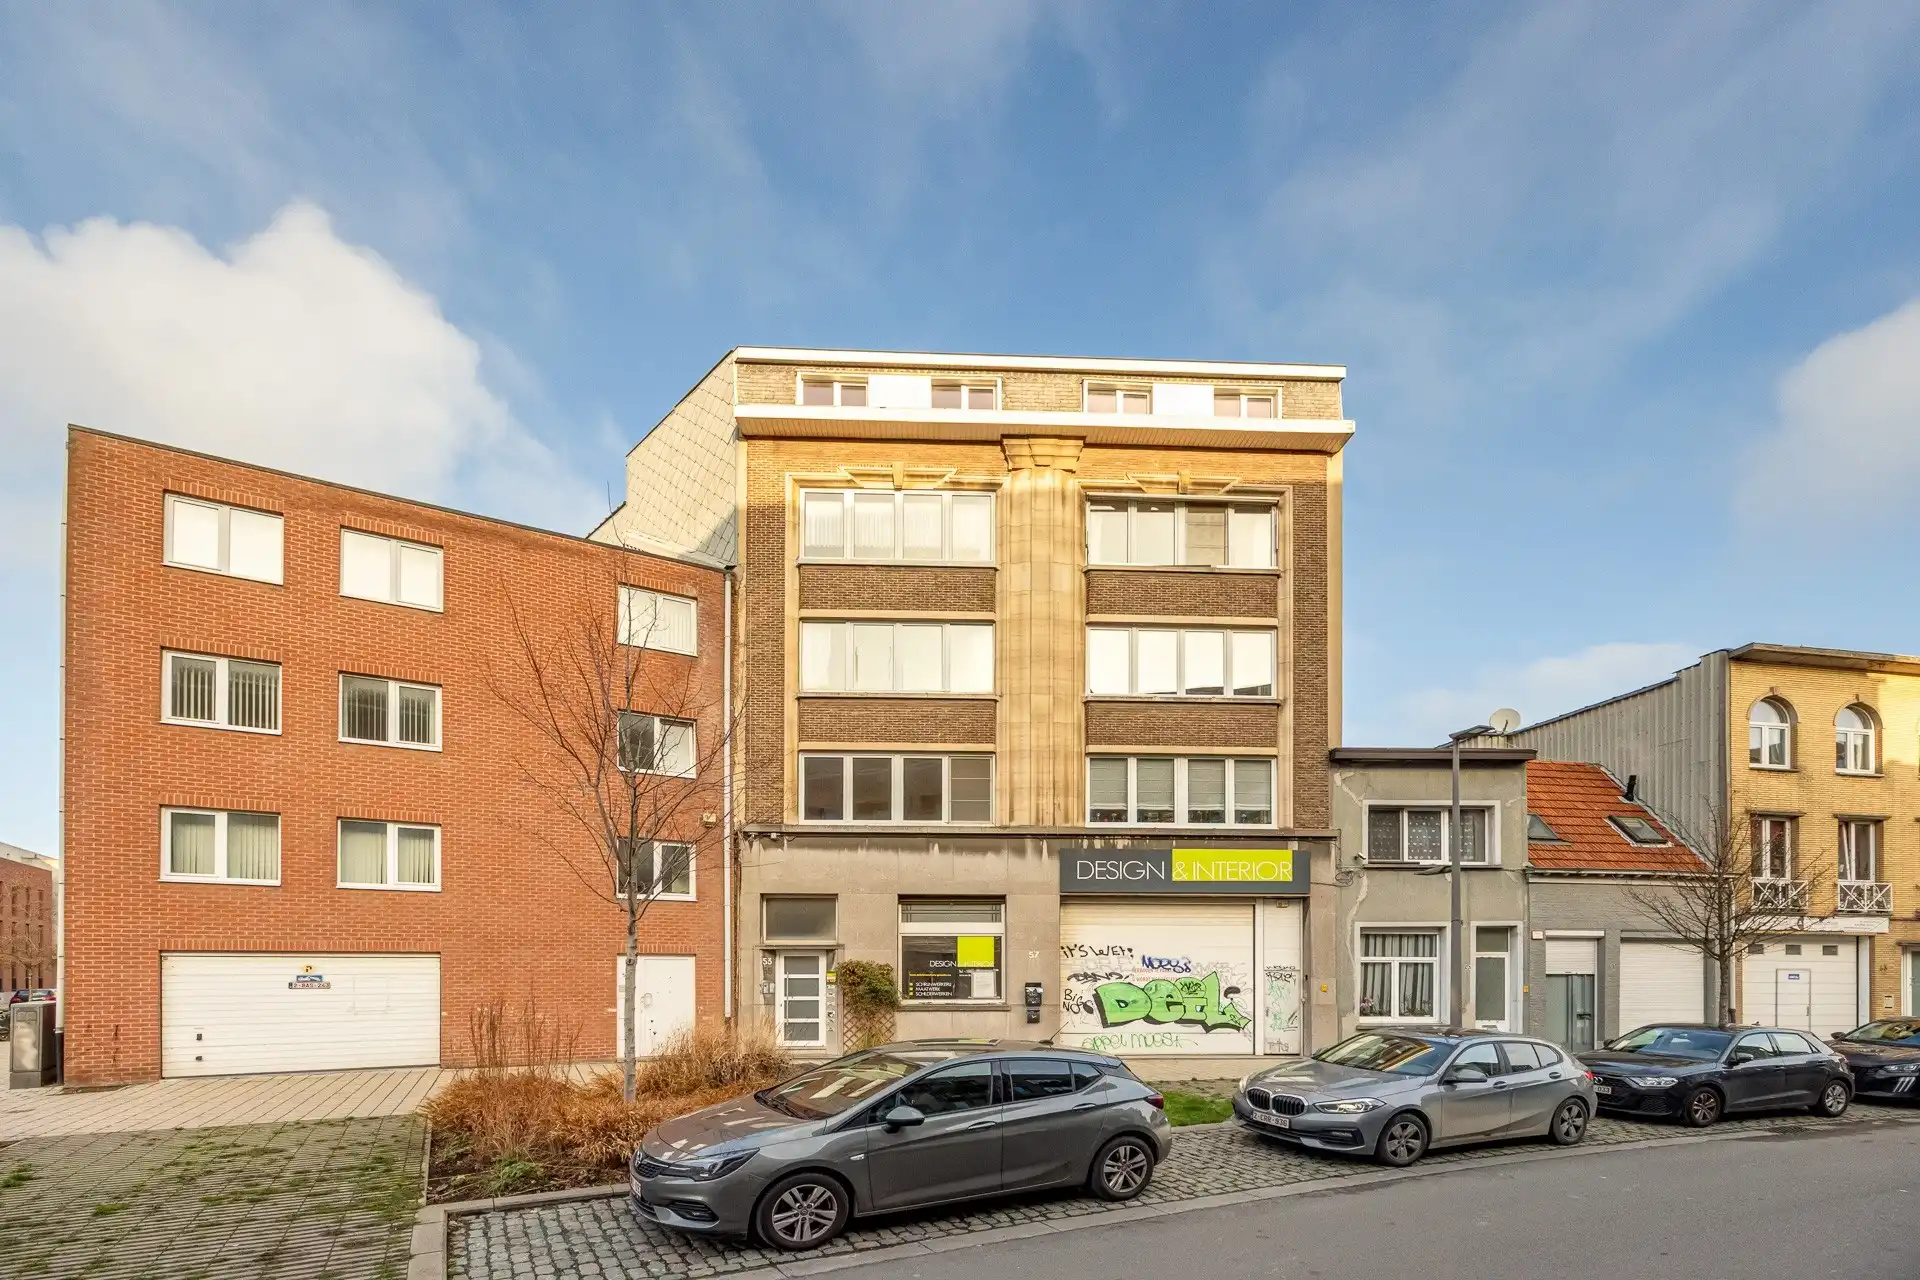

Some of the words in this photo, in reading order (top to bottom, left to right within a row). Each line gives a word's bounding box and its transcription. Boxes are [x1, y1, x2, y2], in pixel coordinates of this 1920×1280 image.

[1076, 860, 1165, 880] DESIGN
[1172, 861, 1189, 880] &
[1192, 860, 1293, 881] INTERIOR
[1028, 951, 1040, 959] 57
[762, 957, 773, 965] 53
[929, 960, 957, 968] DESIGN
